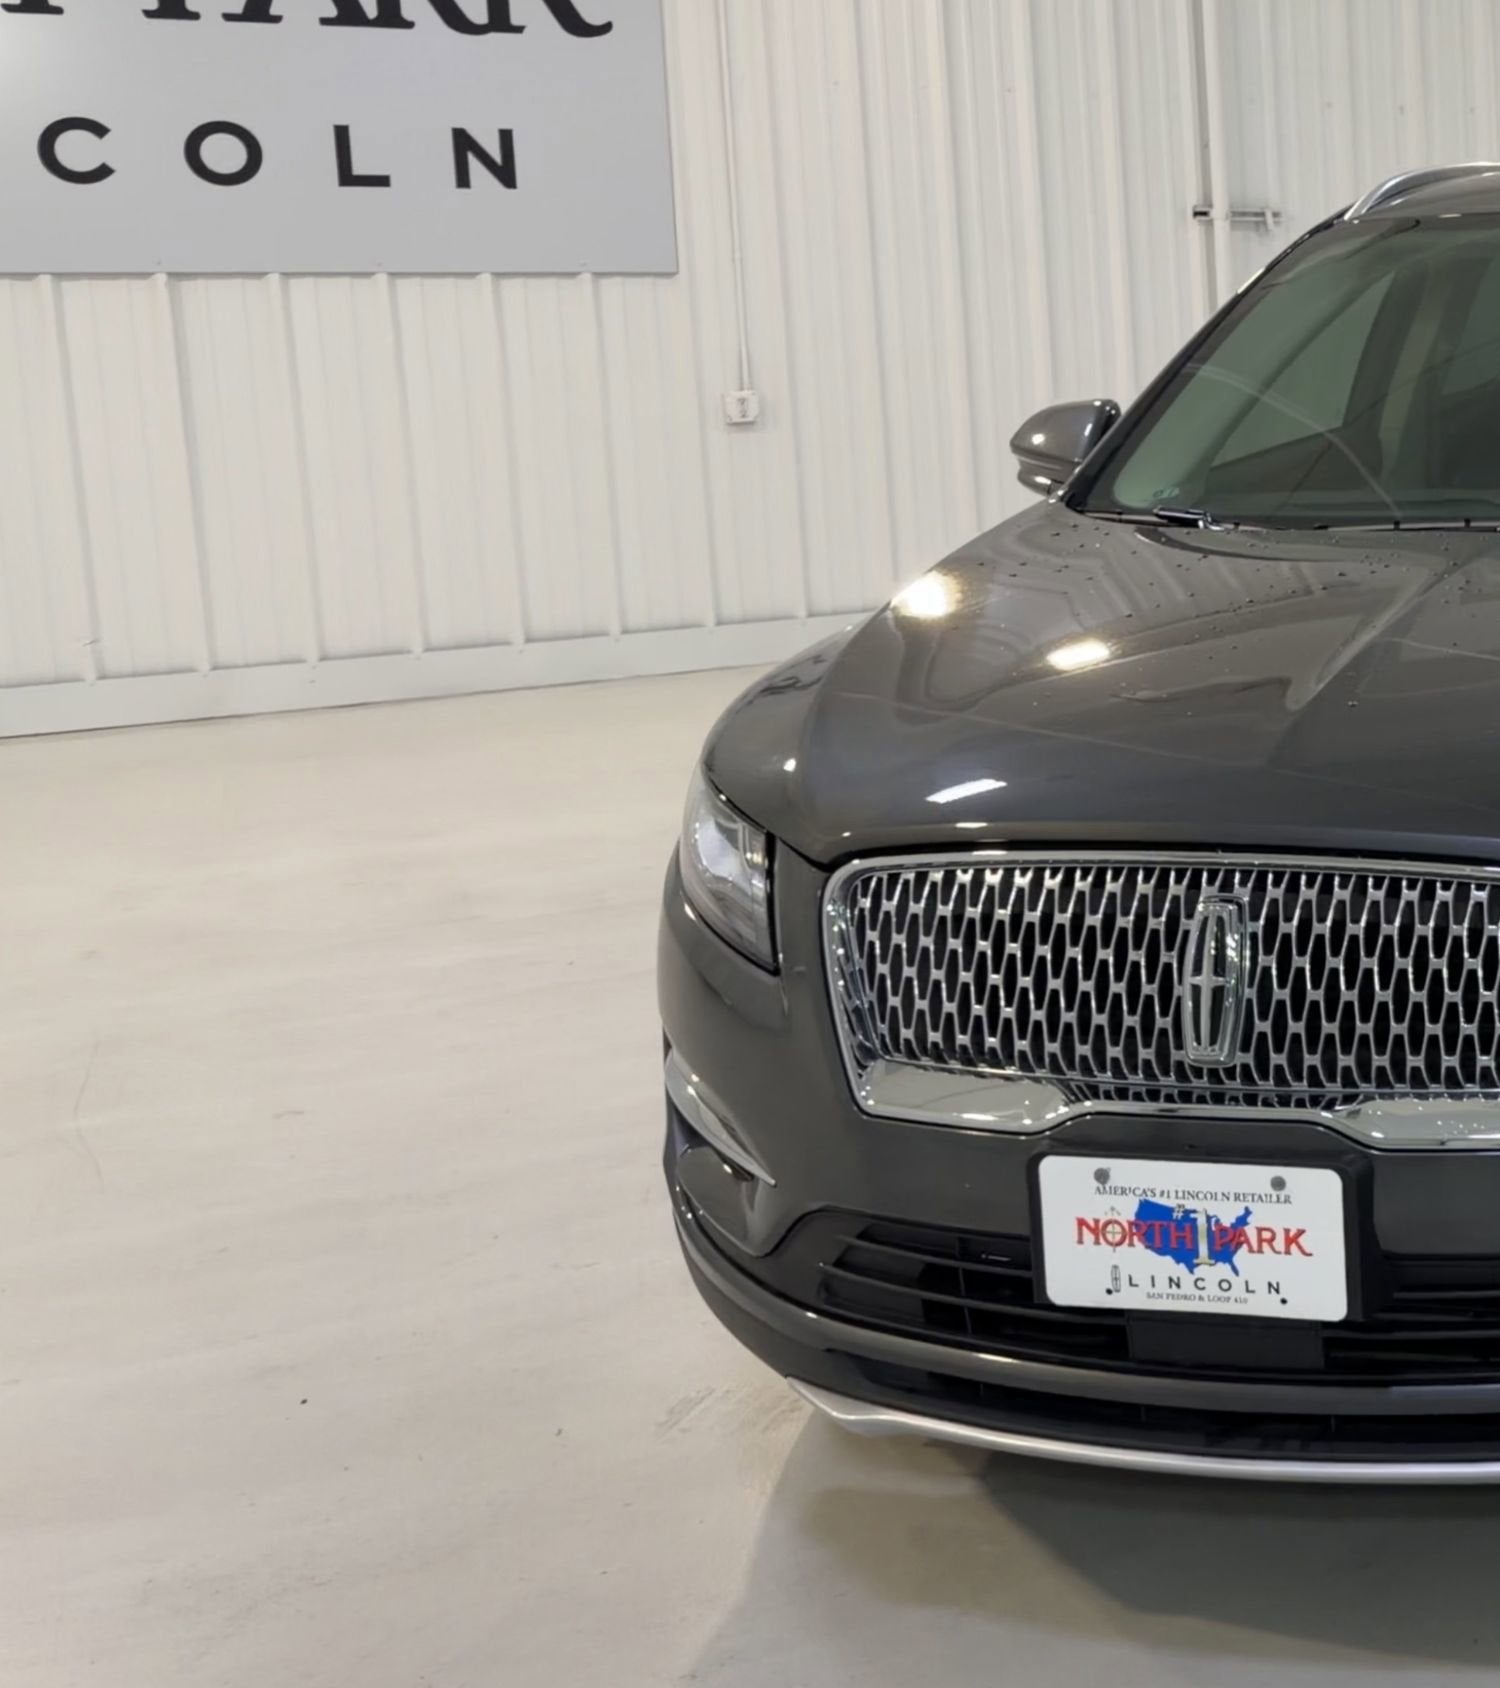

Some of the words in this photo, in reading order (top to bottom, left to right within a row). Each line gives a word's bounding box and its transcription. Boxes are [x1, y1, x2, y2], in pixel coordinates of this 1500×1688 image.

[1094, 1185, 1157, 1198] AMERICA'S
[1159, 1189, 1171, 1200] #1
[1174, 1189, 1231, 1202] LINCOLN
[1233, 1192, 1293, 1205] RETAILER
[1075, 1216, 1195, 1250] NORTH
[1213, 1223, 1314, 1257] PARK
[1127, 1274, 1281, 1295] LINCOLN
